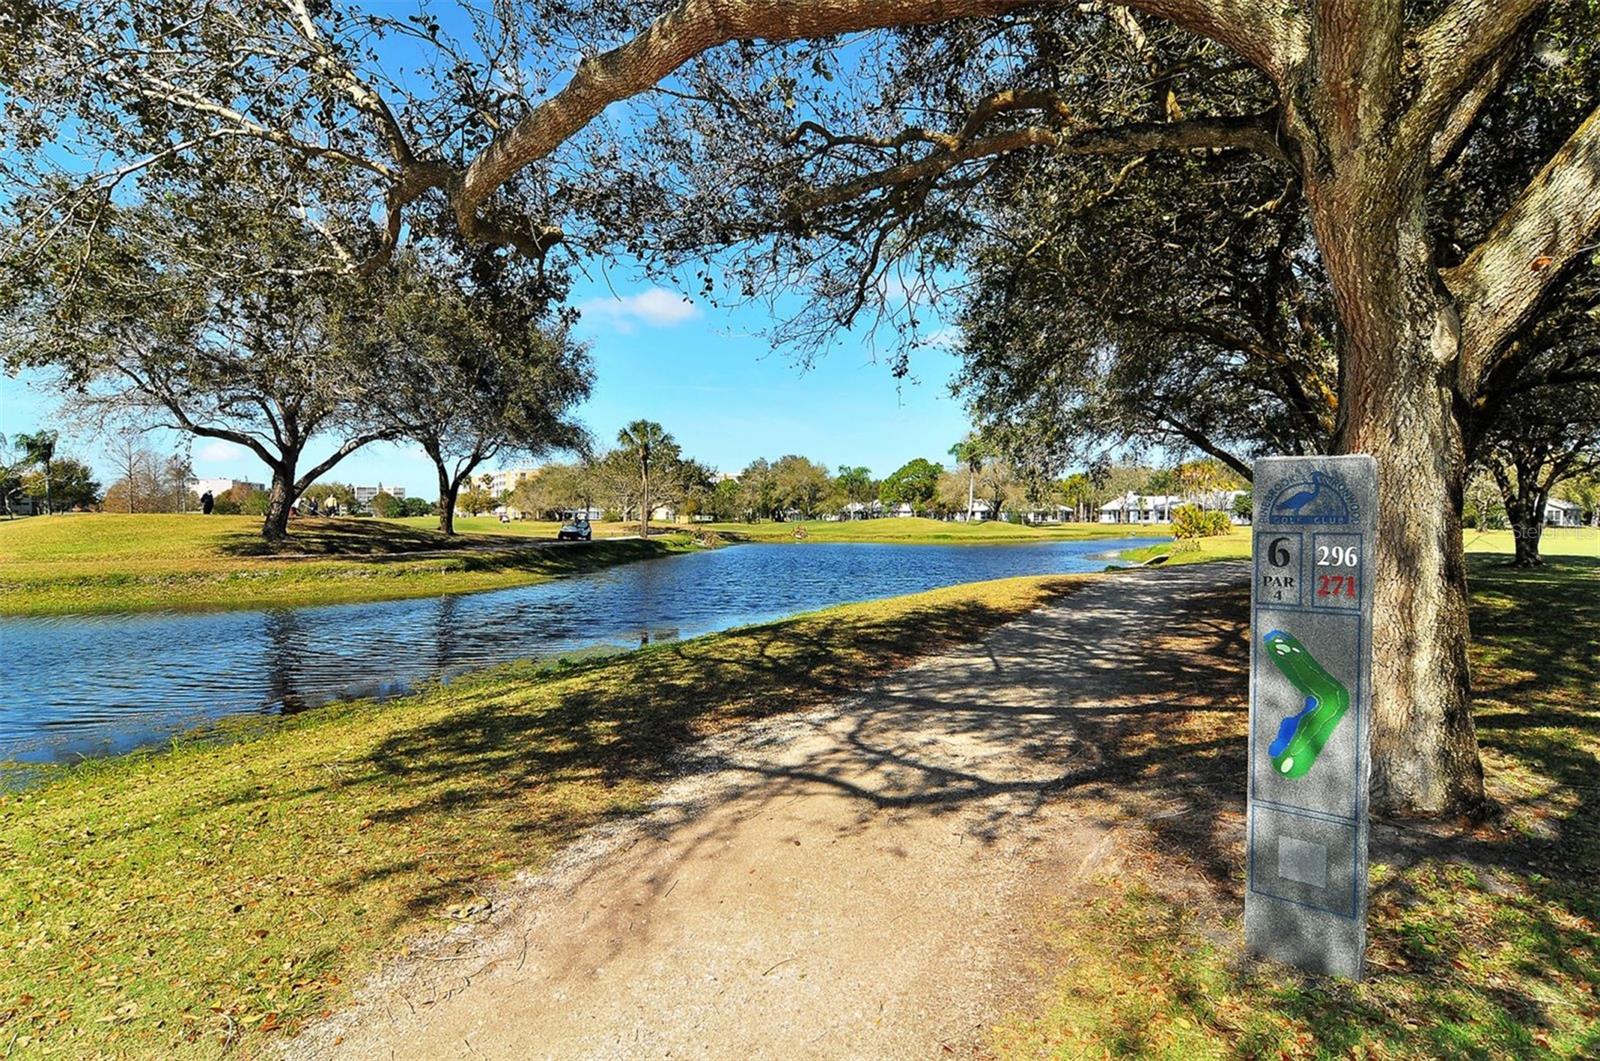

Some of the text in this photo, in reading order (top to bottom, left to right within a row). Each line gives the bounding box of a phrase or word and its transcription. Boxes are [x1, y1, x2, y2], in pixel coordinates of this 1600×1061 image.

[1313, 515, 1344, 523] CLUB
[1268, 537, 1290, 567] 6
[1317, 546, 1357, 567] 296
[1263, 576, 1294, 587] PAR
[1316, 575, 1355, 599] 271
[1273, 590, 1281, 600] 4
